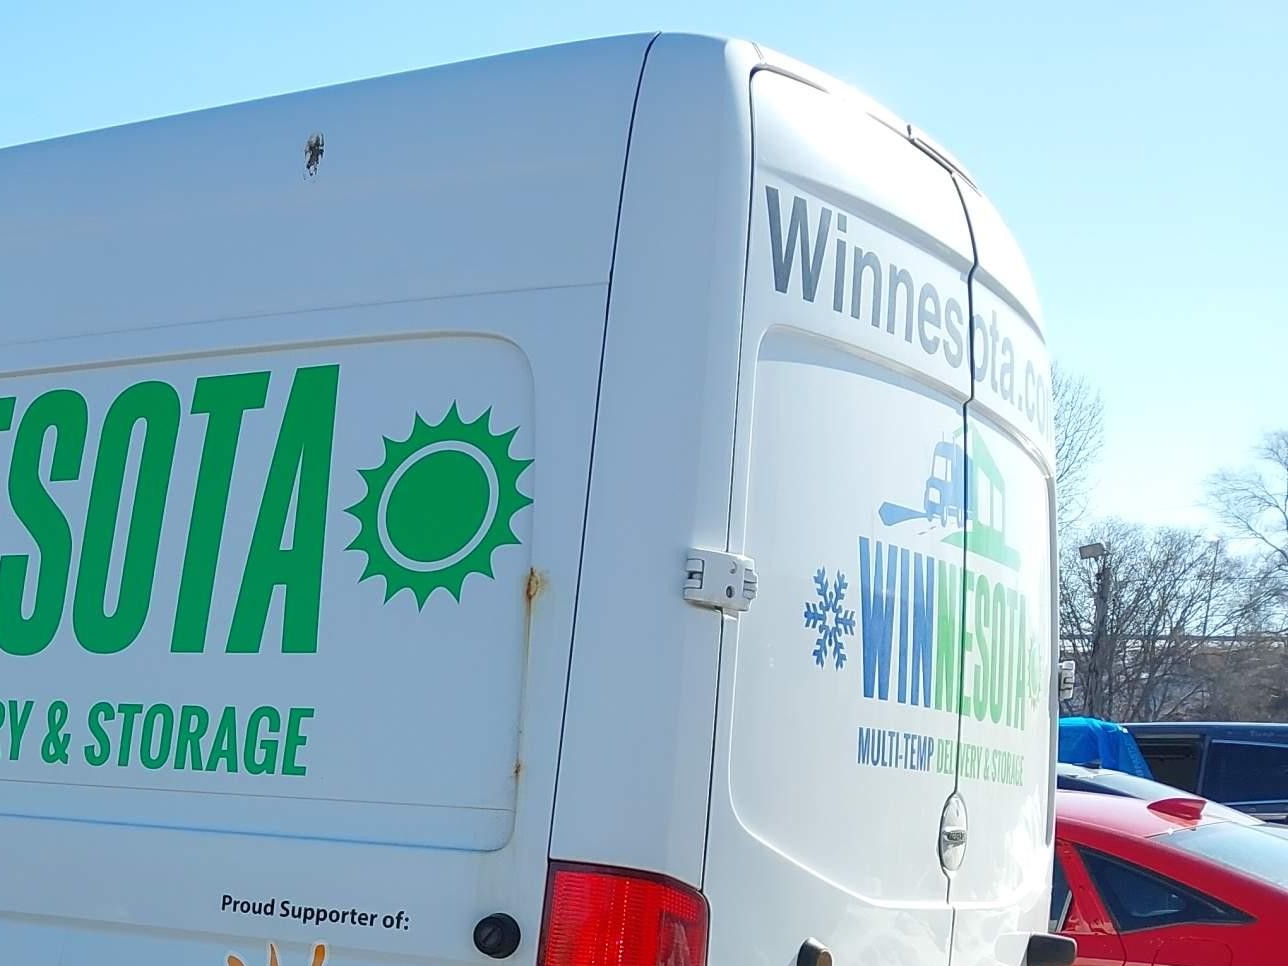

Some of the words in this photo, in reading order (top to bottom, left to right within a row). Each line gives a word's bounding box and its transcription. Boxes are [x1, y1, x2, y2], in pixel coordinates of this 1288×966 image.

[858, 535, 1028, 731] WINNESOTA
[41, 701, 71, 765] &
[83, 701, 315, 777] STORAGE
[857, 726, 935, 773] MULTI-TEMP
[991, 749, 1025, 787] STORAGE
[221, 894, 275, 916] Proud
[279, 899, 378, 928] Supporter
[382, 910, 410, 931] of:
